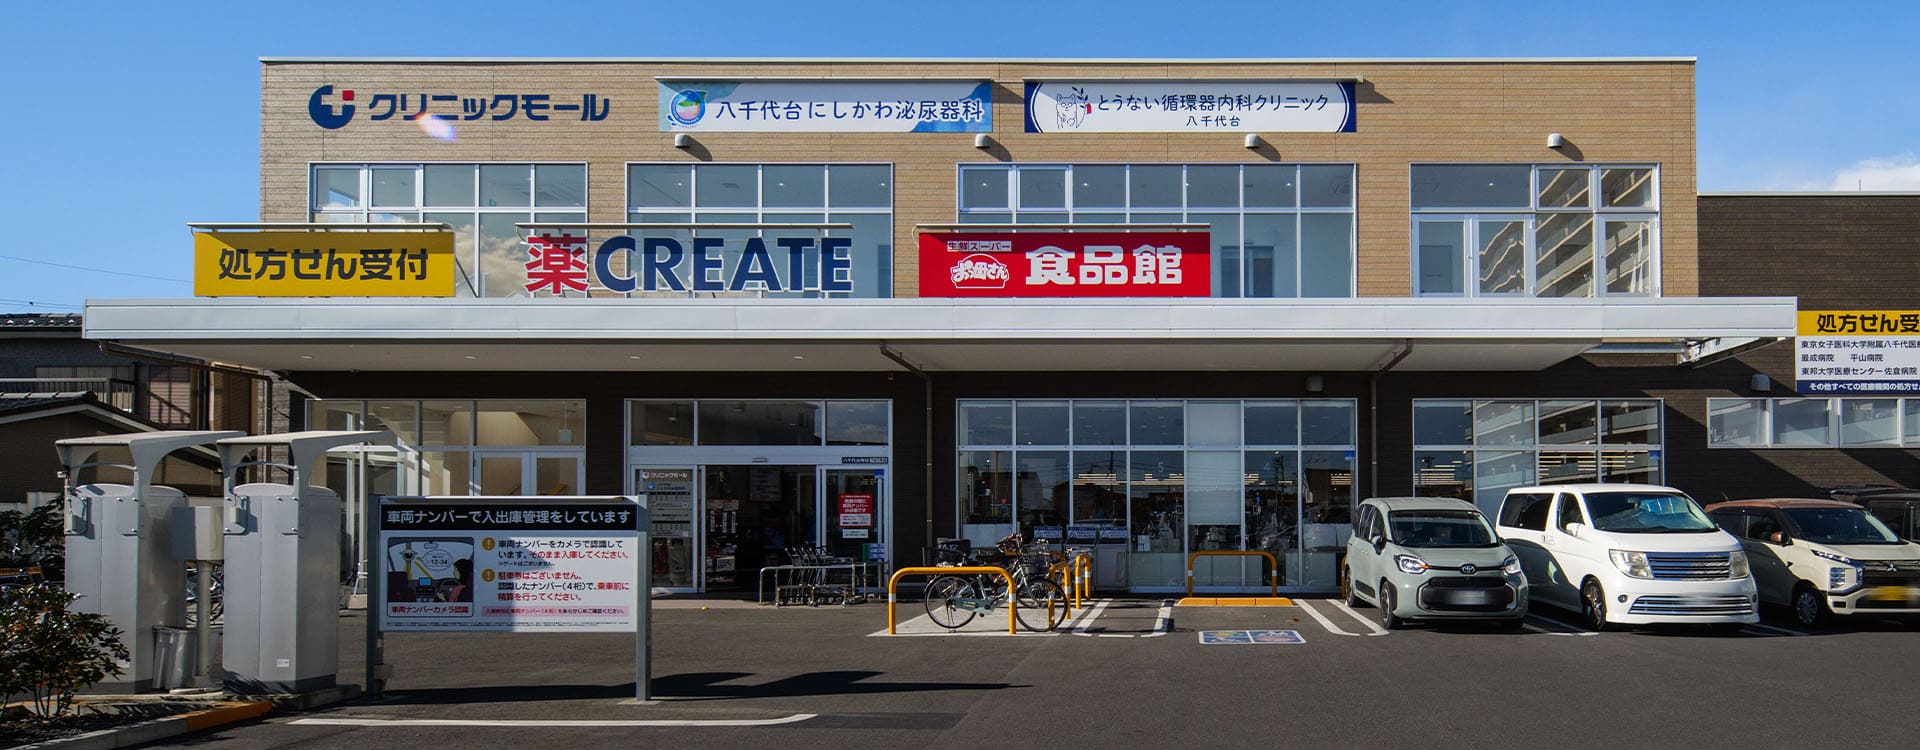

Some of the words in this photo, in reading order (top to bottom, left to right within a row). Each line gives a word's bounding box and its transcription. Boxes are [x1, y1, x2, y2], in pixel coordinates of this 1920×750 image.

[369, 93, 610, 121] クリニックモール
[1098, 94, 1329, 112] とうない循環器内科クリニック
[1186, 115, 1241, 127] 八千代台
[948, 241, 1011, 251] 生鮮スーパー
[218, 248, 428, 281] 処方せん受付
[524, 233, 589, 294] 薬
[594, 235, 853, 293] CREATE
[952, 260, 1009, 283] お母さん
[1025, 244, 1183, 285] 食品館
[1817, 313, 1920, 333] 処方せん受
[1850, 354, 1884, 362] 平山病院
[1809, 383, 1920, 391] その他すべての医療機関の処方せ
[386, 510, 631, 525] 車両ナンバーで入出庫管理をしています
[498, 540, 623, 548] 車両ナンバーをカメラで認識して
[498, 572, 582, 580] 駐車券はございません。
